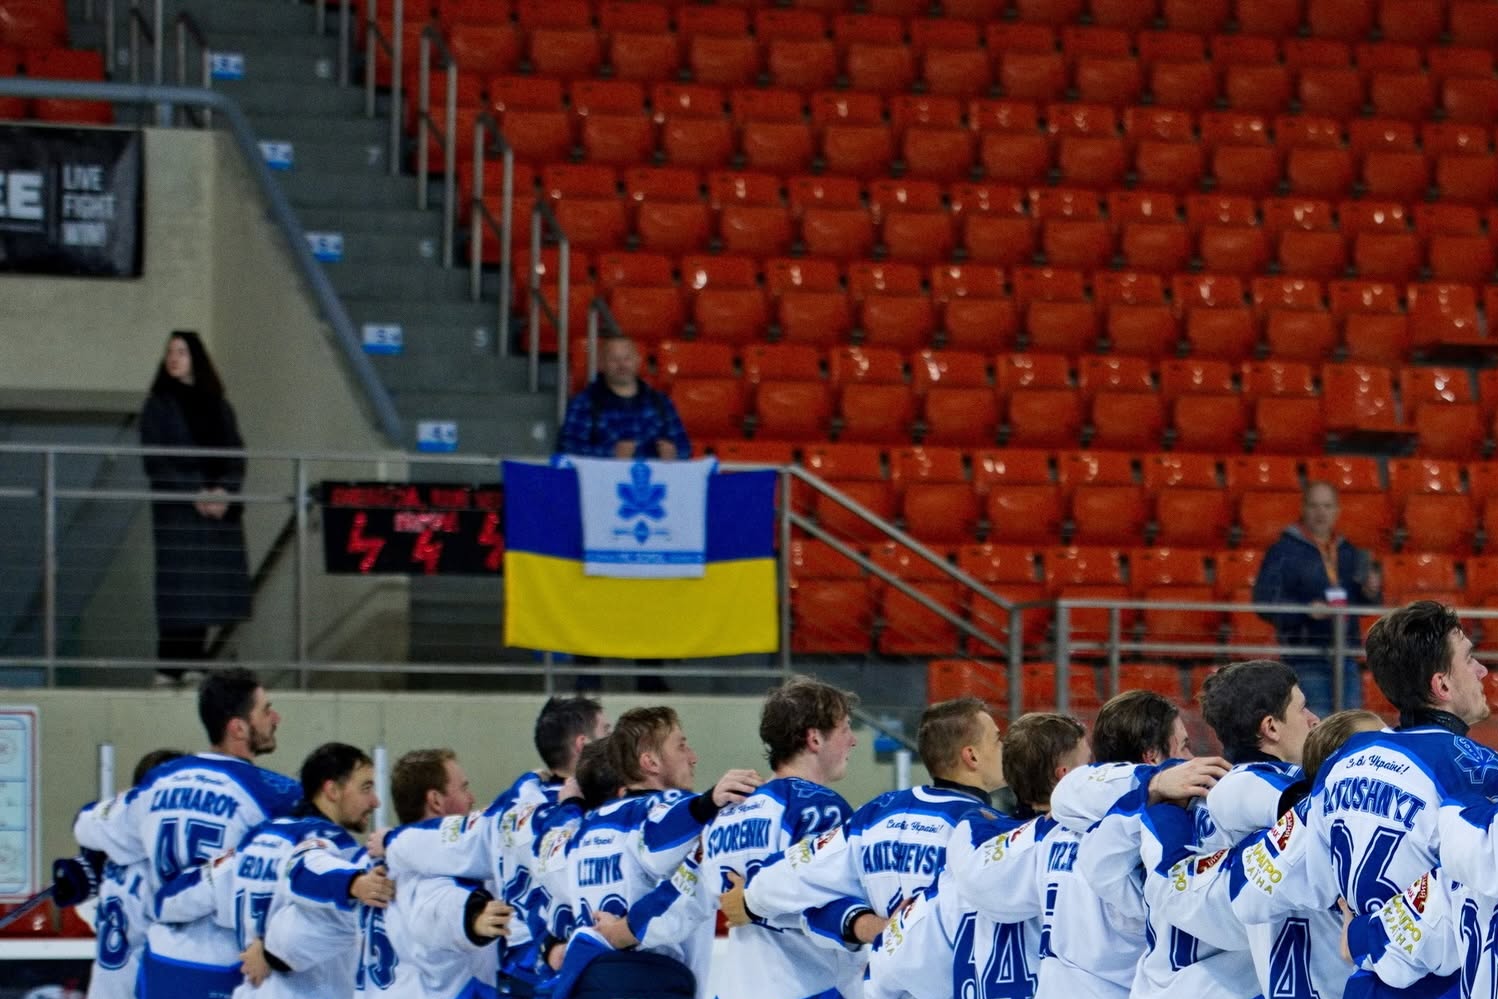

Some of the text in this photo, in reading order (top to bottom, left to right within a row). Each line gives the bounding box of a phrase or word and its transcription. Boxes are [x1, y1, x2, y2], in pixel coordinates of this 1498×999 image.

[0, 170, 43, 221] E
[1368, 754, 1410, 775] Україні!
[801, 805, 841, 834] 22
